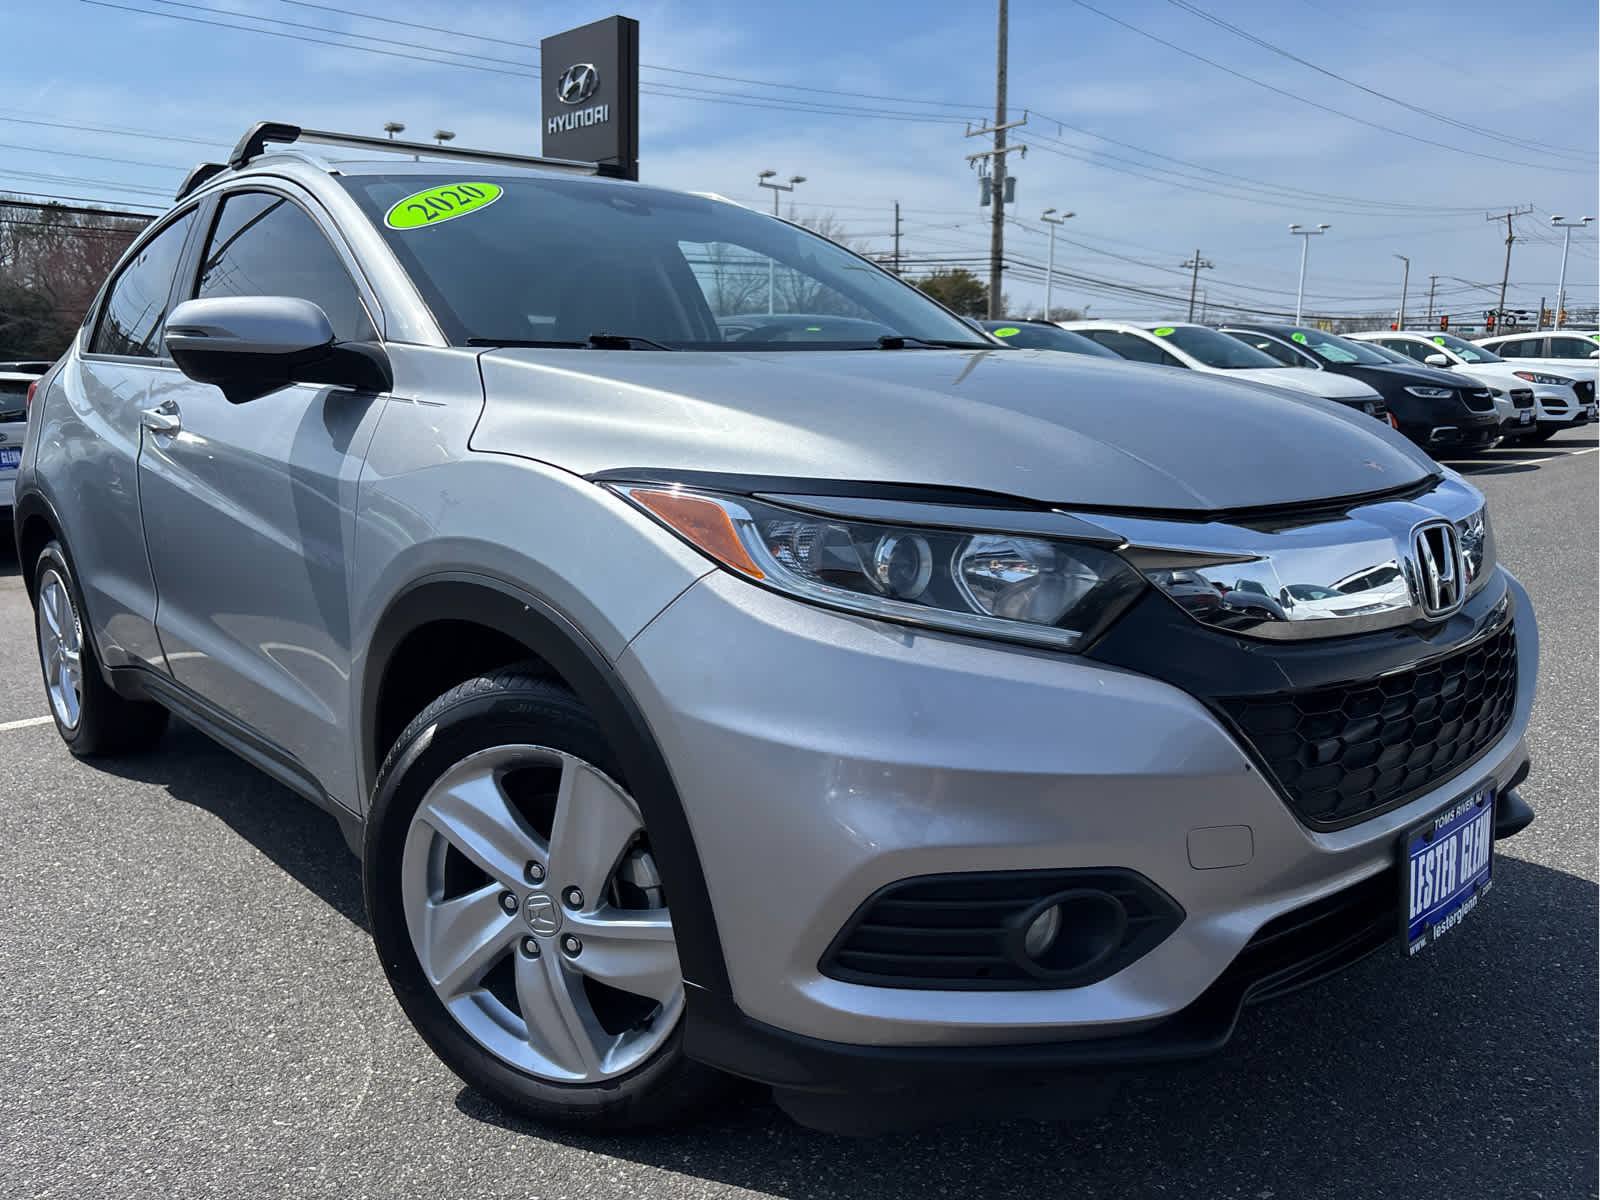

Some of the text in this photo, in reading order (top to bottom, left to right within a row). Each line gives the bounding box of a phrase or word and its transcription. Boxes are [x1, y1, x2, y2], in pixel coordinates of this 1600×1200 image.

[547, 104, 609, 134] HYUNDAI
[407, 185, 486, 221] 2020
[1434, 809, 1456, 831] TOMS
[1456, 797, 1475, 819] RIVER
[1409, 807, 1492, 920] LESTER GLENN
[1433, 895, 1478, 940] lesterglenn
